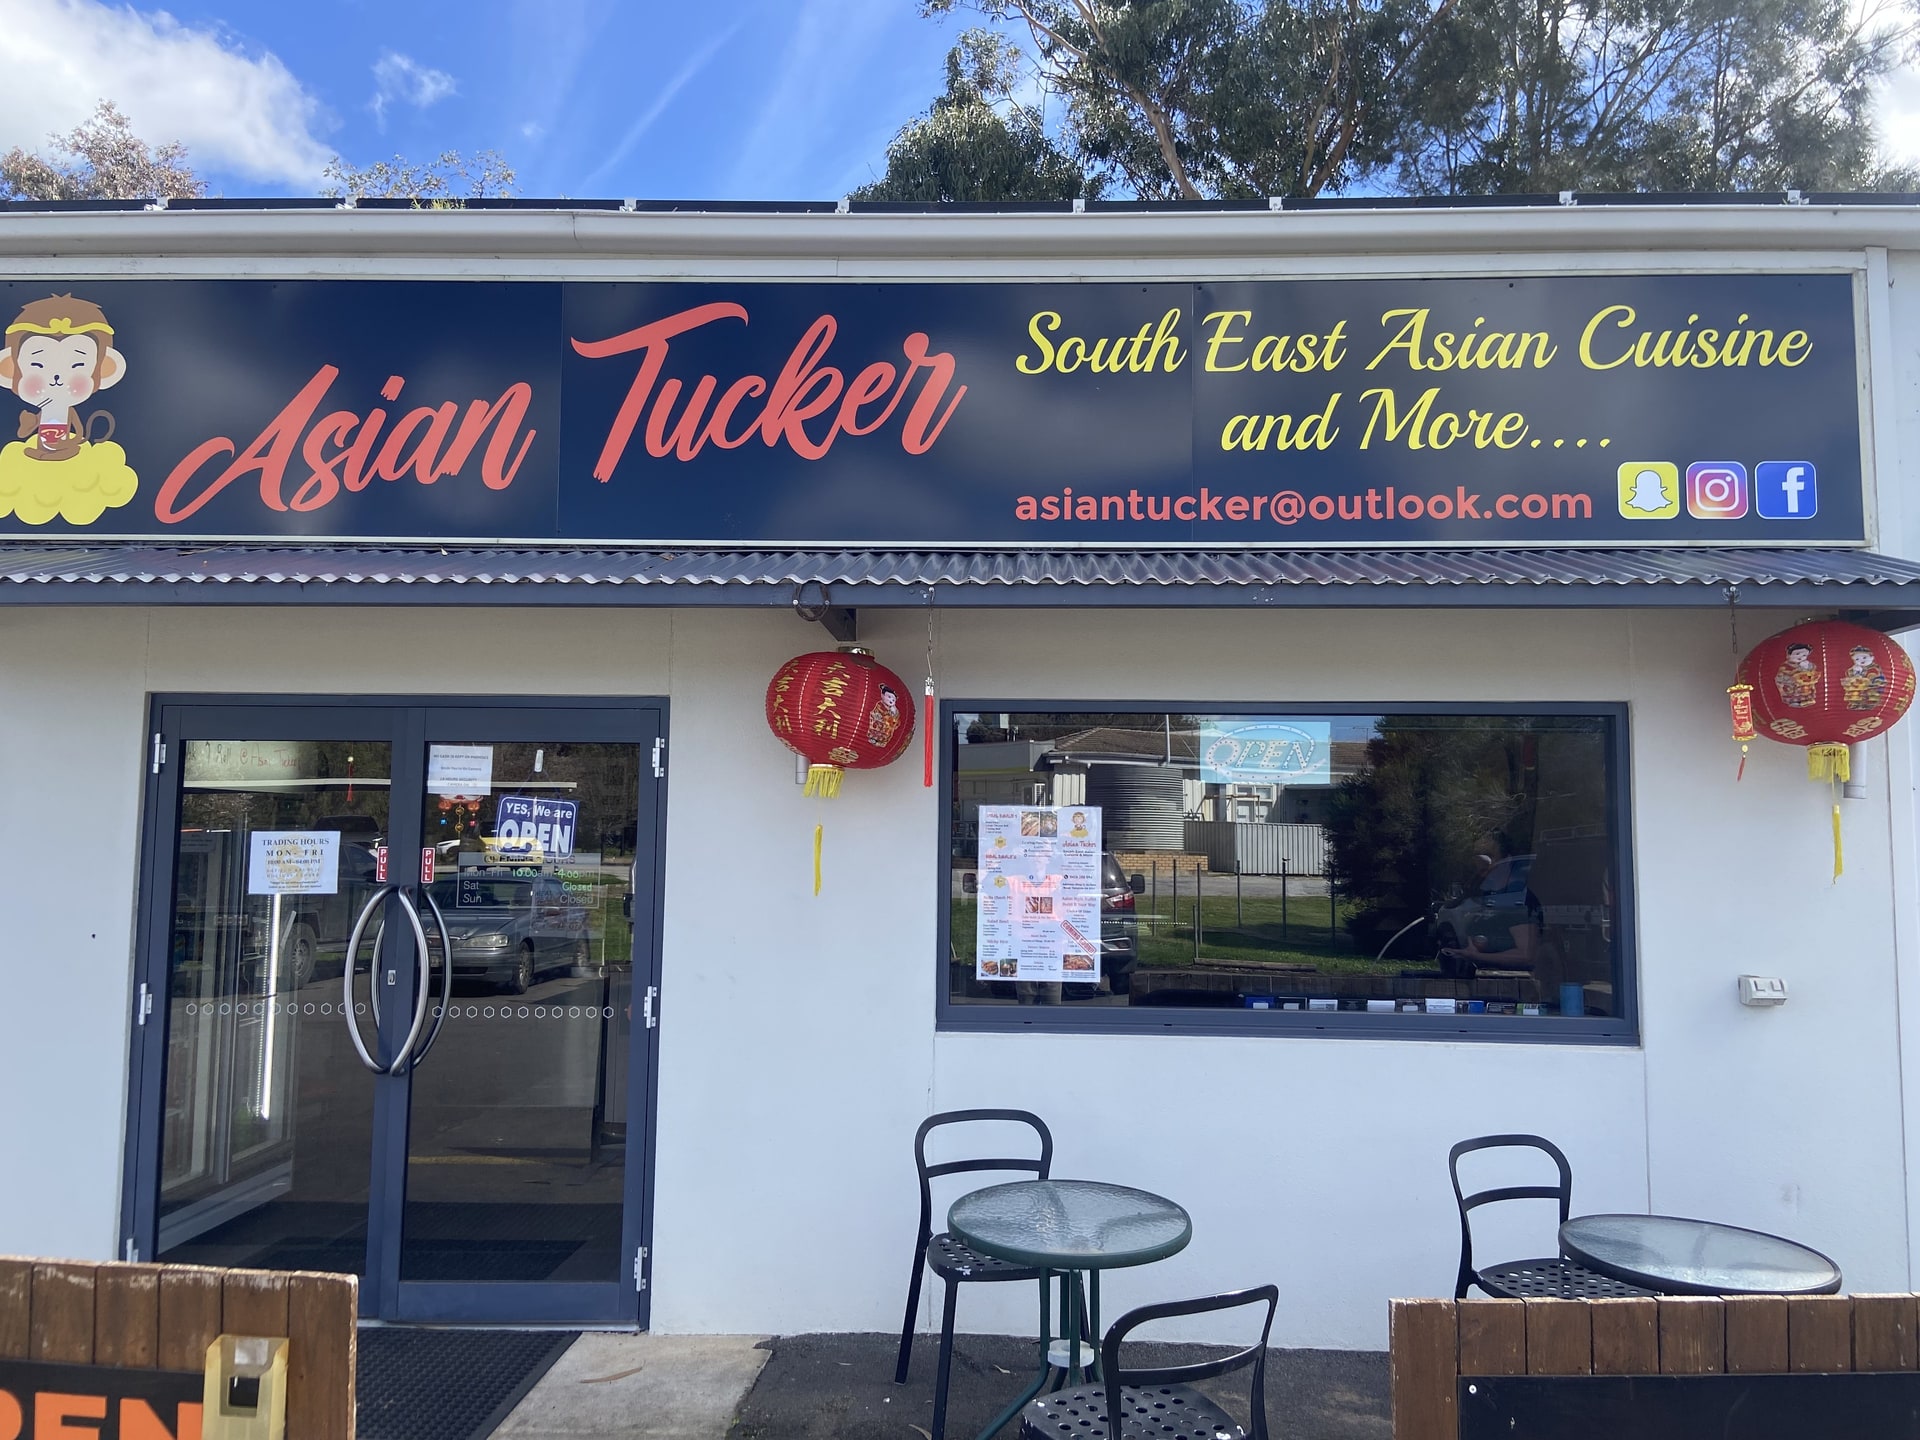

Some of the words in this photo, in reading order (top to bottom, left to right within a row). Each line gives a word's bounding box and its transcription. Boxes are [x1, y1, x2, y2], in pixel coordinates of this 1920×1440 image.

[1016, 308, 1186, 375] South
[1203, 310, 1347, 373] East
[1366, 308, 1557, 371] Asian
[1578, 305, 1813, 370] Cuisine
[155, 365, 537, 523] Asian
[571, 302, 967, 482] Tucker
[1221, 393, 1340, 452] and
[1016, 487, 1592, 525] asiantucker@outlook.com
[1206, 737, 1315, 770] OPEN
[506, 803, 531, 818] YES,
[534, 803, 551, 818] We
[554, 808, 573, 818] are
[300, 838, 330, 846] HOURS
[499, 819, 571, 853] OPEN
[379, 849, 387, 880] PULL
[424, 850, 432, 881] PULL
[462, 893, 482, 903] Sun
[559, 894, 594, 904] Closed
[463, 881, 480, 890] Sat
[562, 882, 593, 892] Closed
